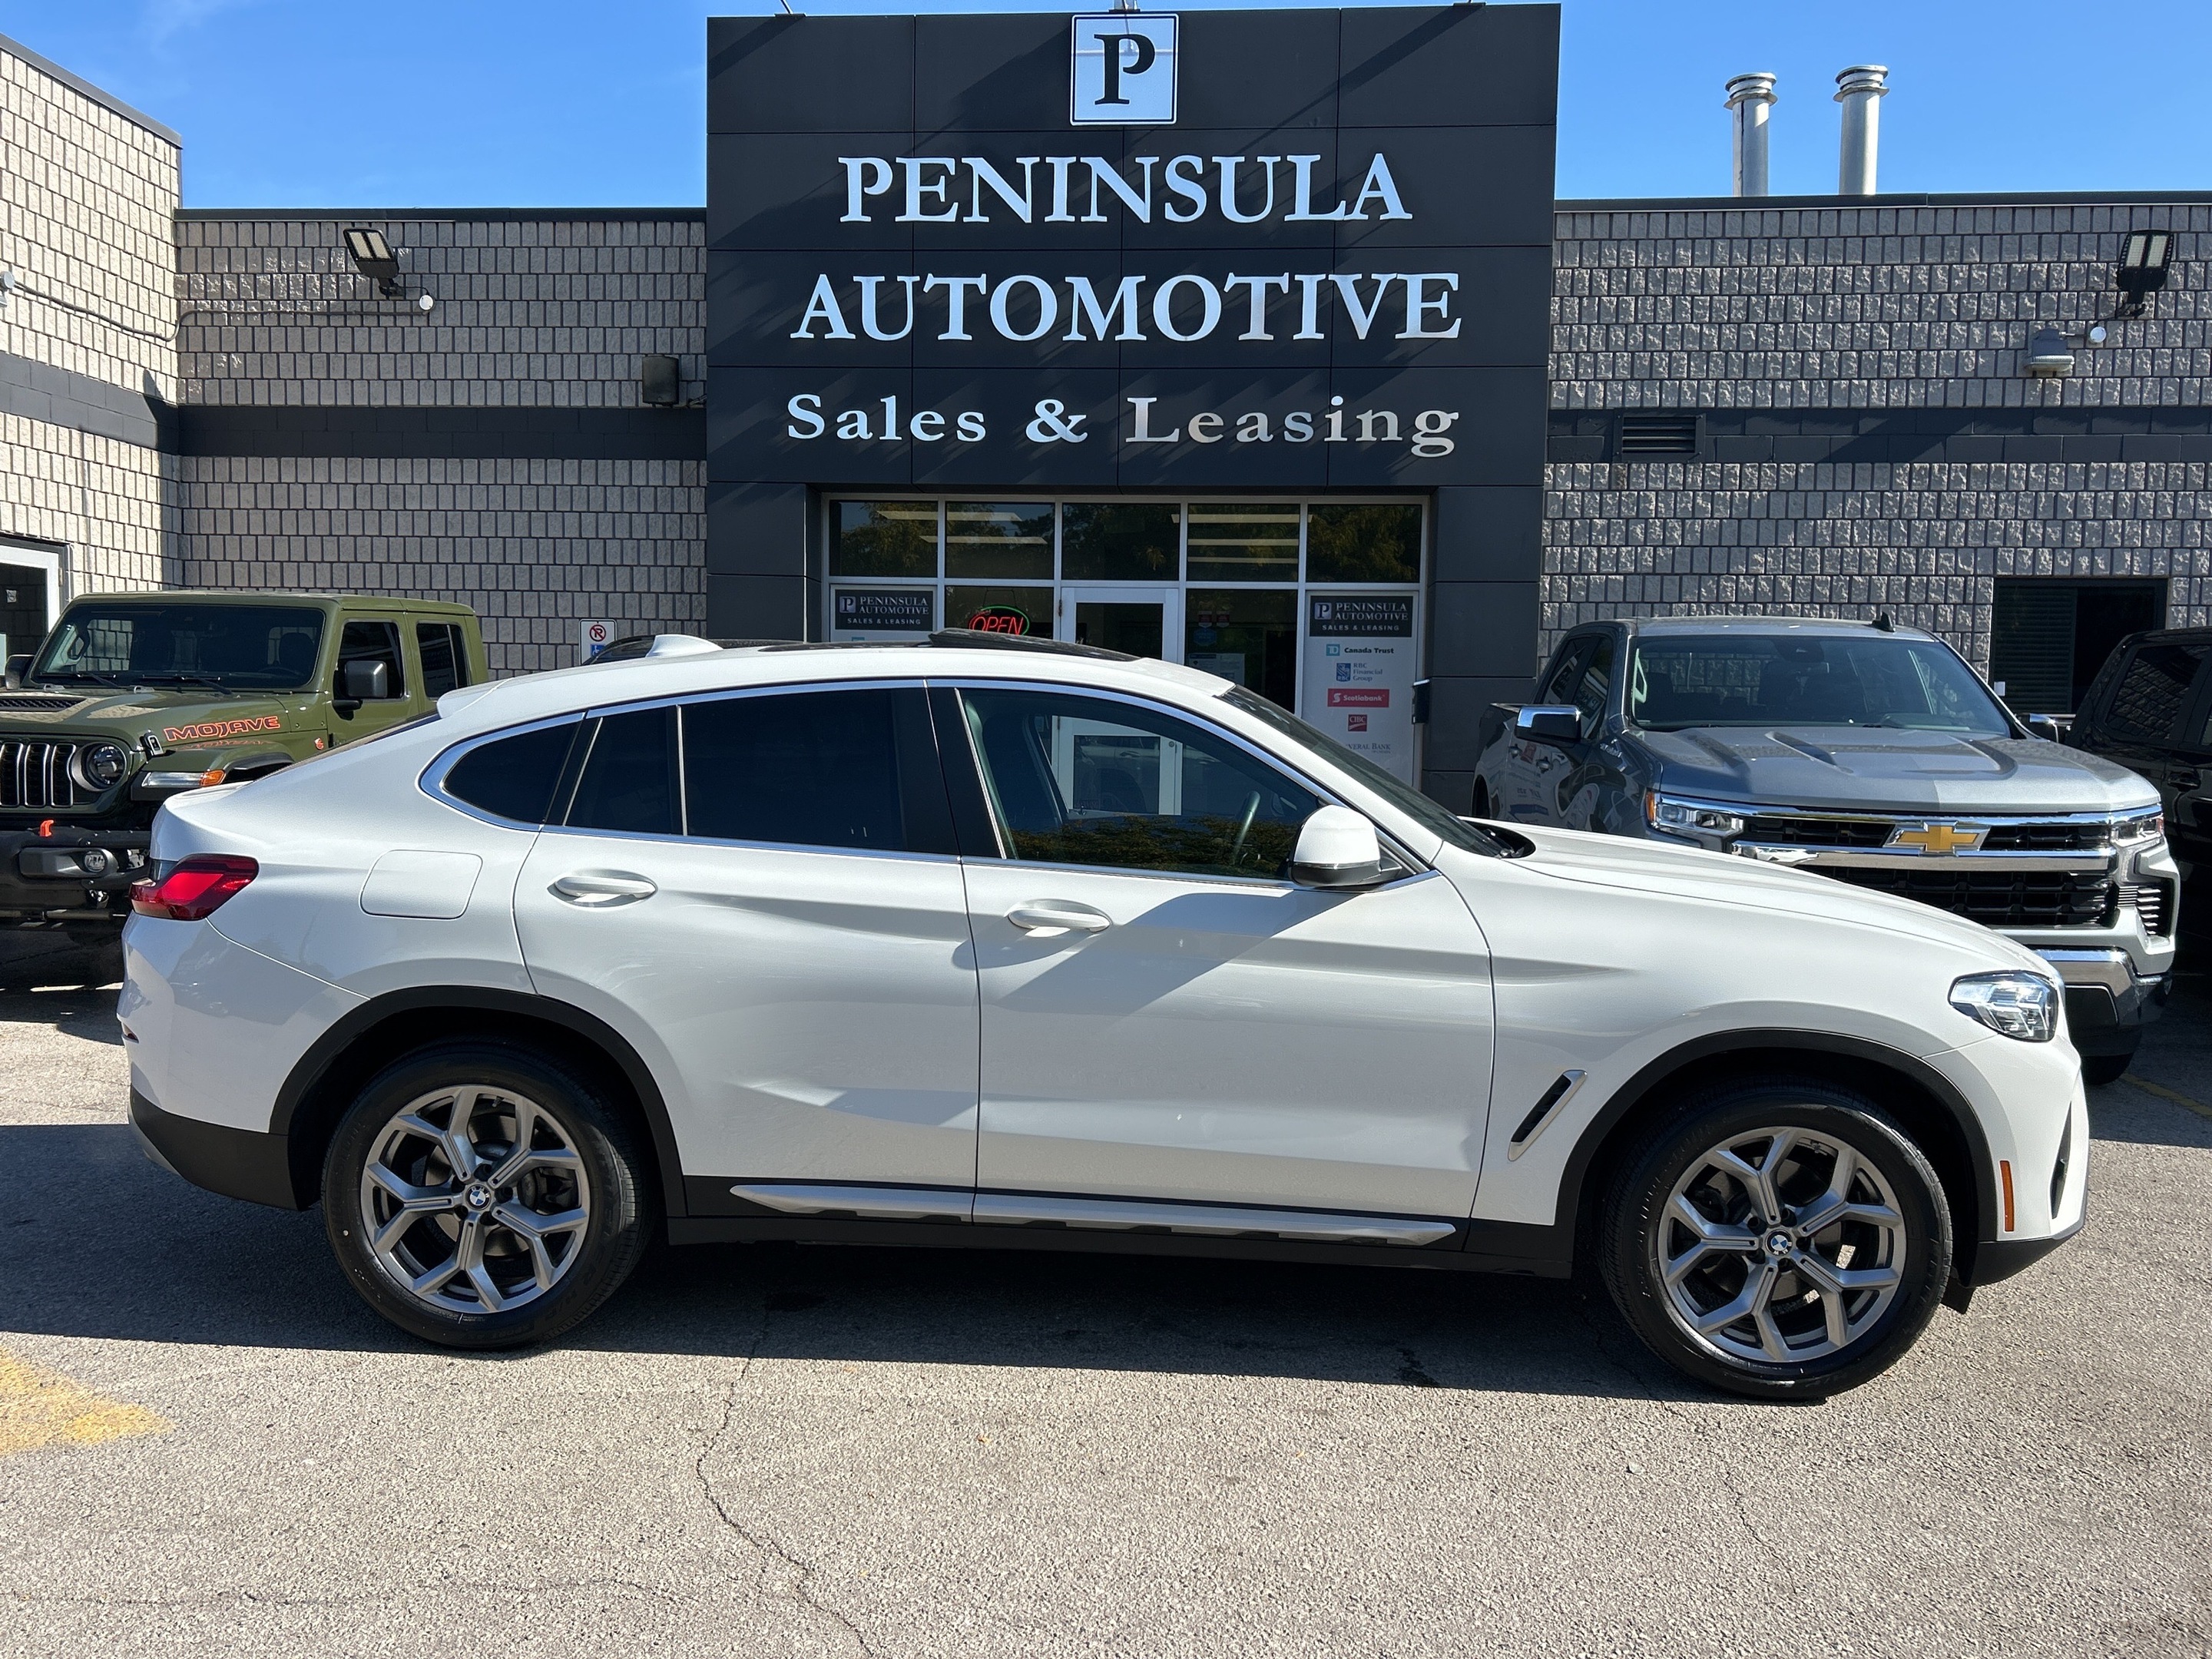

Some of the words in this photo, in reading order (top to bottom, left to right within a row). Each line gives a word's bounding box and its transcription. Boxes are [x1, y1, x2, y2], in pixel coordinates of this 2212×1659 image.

[1094, 32, 1156, 105] P
[839, 153, 1412, 224] PENINSULA
[790, 271, 1462, 342] AUTOMOTIVE
[787, 393, 987, 442] Sales
[1025, 398, 1088, 442] &
[1126, 395, 1459, 458] Leasing
[842, 598, 854, 612] P
[859, 596, 929, 606] PENINSULA
[1336, 602, 1408, 612] PENINSULA
[859, 606, 929, 615] AUTOMOTIVE
[1316, 604, 1330, 618] P
[1334, 612, 1409, 621] AUTOMOTIVE
[972, 616, 1025, 636] OPEN
[1328, 646, 1339, 654] TD
[164, 716, 280, 741] MOJAVE
